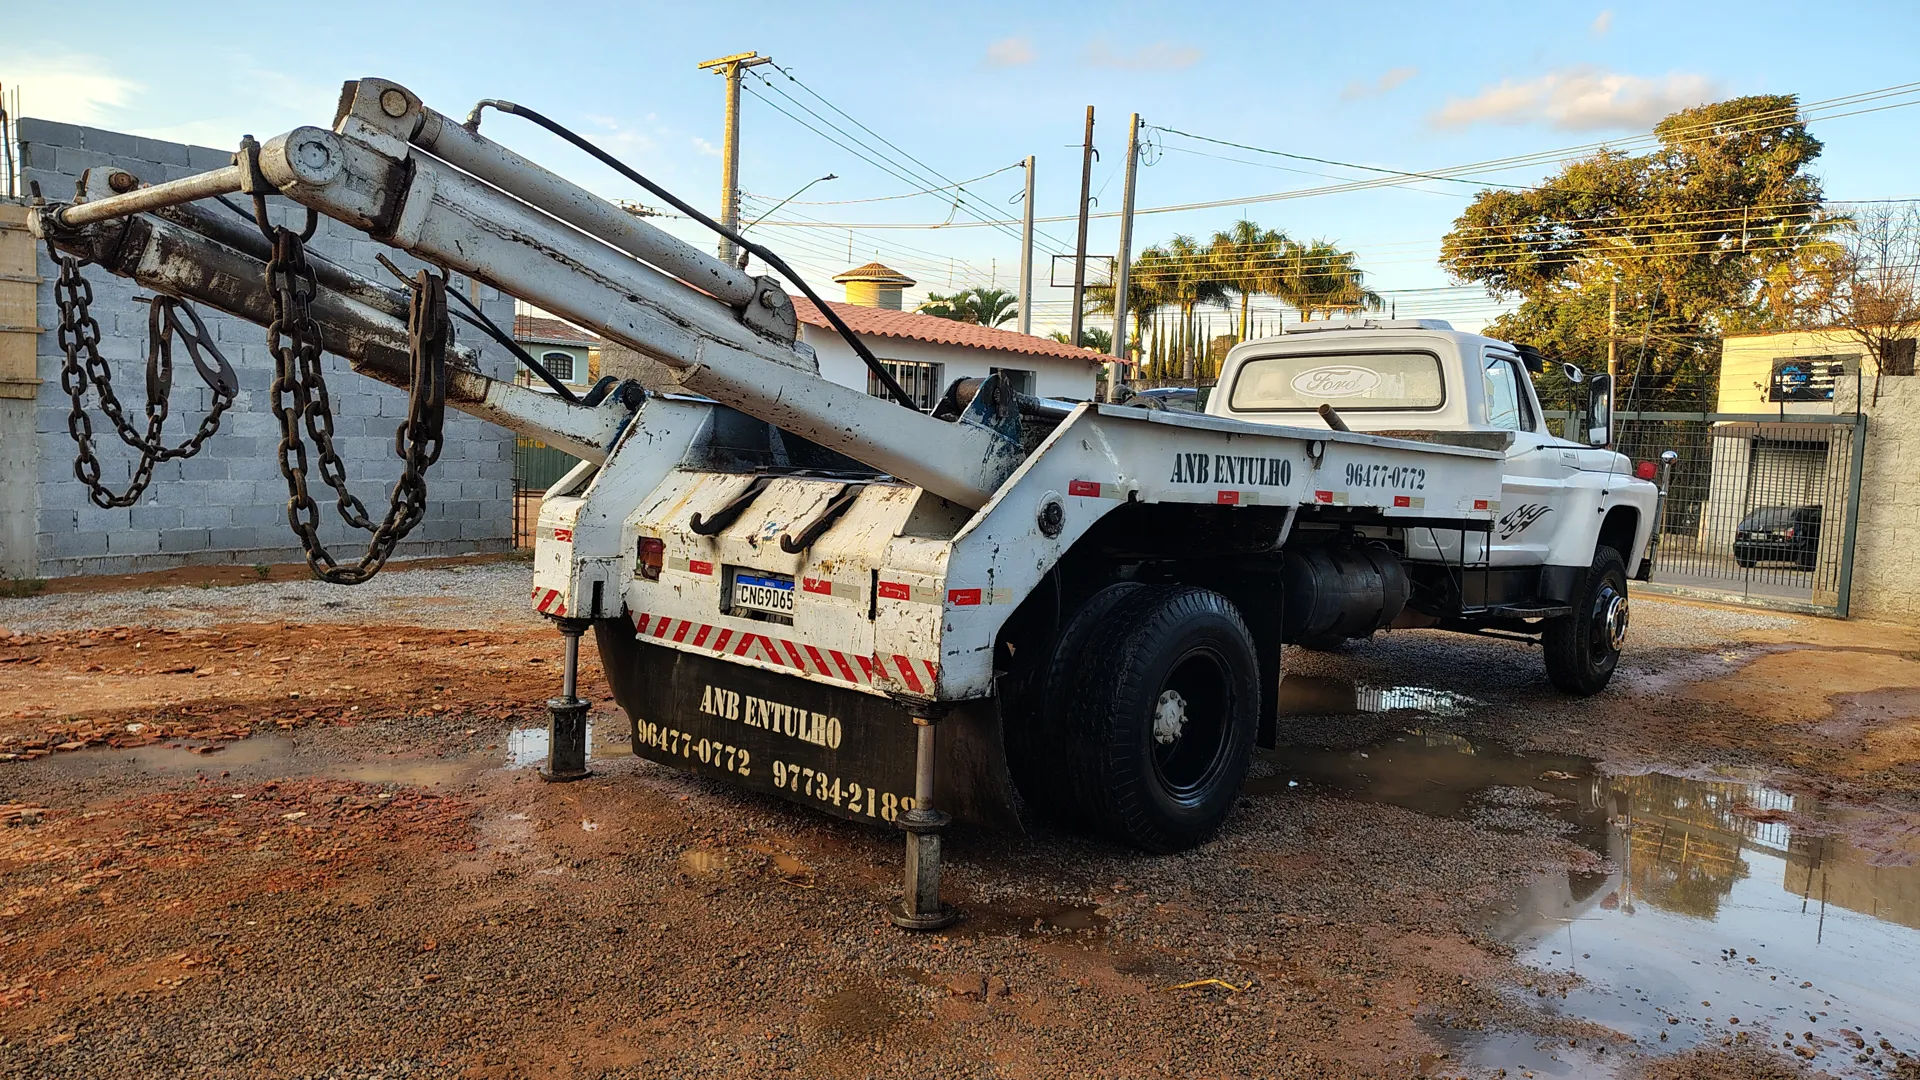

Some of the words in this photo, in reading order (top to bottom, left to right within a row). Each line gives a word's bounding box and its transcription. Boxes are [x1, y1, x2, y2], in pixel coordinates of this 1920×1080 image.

[1306, 370, 1362, 391] Ford
[1170, 453, 1210, 484] ANB
[1213, 455, 1292, 487] ENTULHO
[1345, 463, 1426, 490] 96477-0772
[741, 586, 793, 611] CNG9D65
[699, 685, 740, 721] ANB
[744, 695, 842, 749] ENTULHO
[637, 718, 751, 776] 96477-0772
